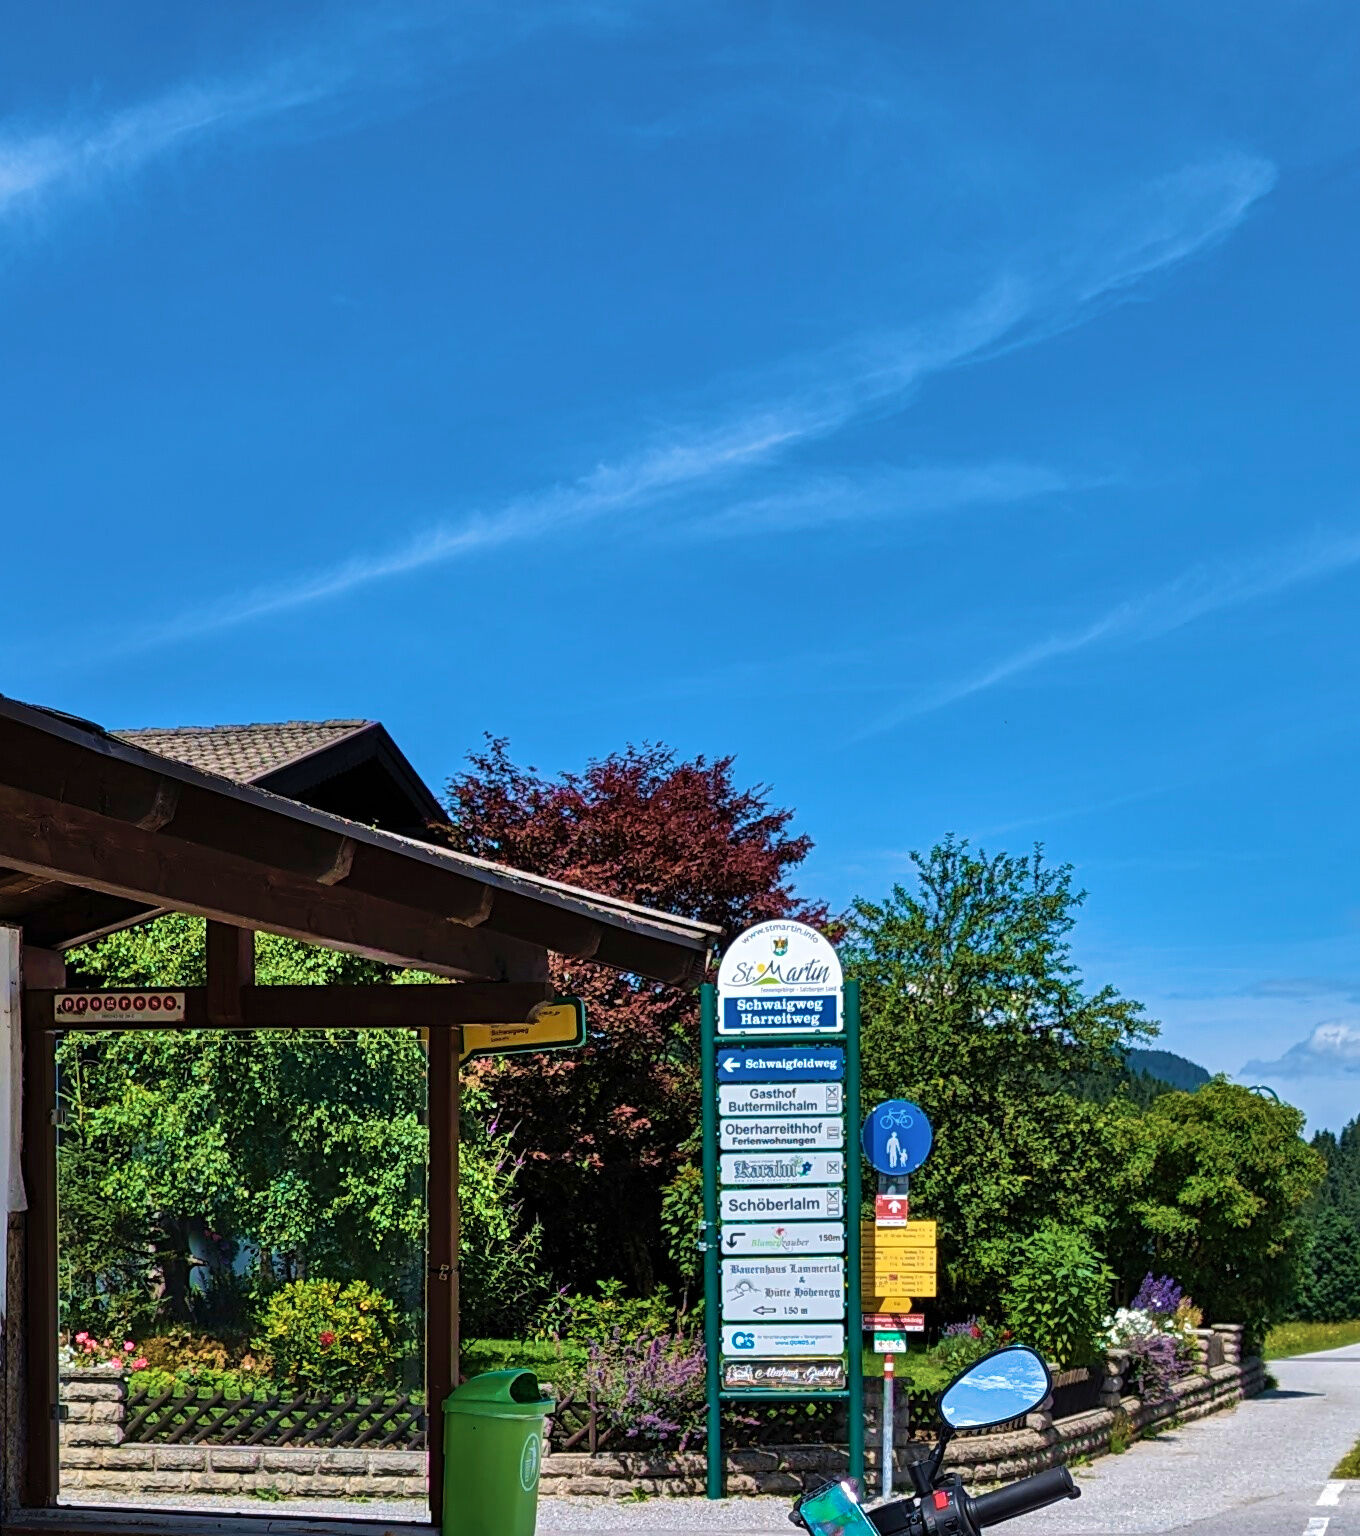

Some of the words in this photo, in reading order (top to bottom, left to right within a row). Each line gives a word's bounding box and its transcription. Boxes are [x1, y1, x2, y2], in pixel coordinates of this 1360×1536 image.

[741, 924, 818, 944] www.stmartin.info
[732, 961, 756, 983] St.
[757, 958, 830, 984] Martin
[63, 996, 175, 1012] progress
[737, 998, 823, 1012] Schwaigweg
[741, 1013, 820, 1026] Harreitweg
[745, 1059, 837, 1070] Schwaigfeldweg
[750, 1088, 796, 1099] Gasthof
[728, 1101, 817, 1112] Buttermilchalm
[725, 1122, 823, 1135] Oberharreithhof
[732, 1137, 816, 1146] Ferienwohnungen
[734, 1159, 797, 1178] Karalm
[728, 1197, 820, 1212] Schöberlalm
[730, 1264, 787, 1275] Bauernhaus
[790, 1263, 840, 1274] Lammertal
[764, 1287, 791, 1299] Hütte
[794, 1287, 840, 1298] Höhenegg
